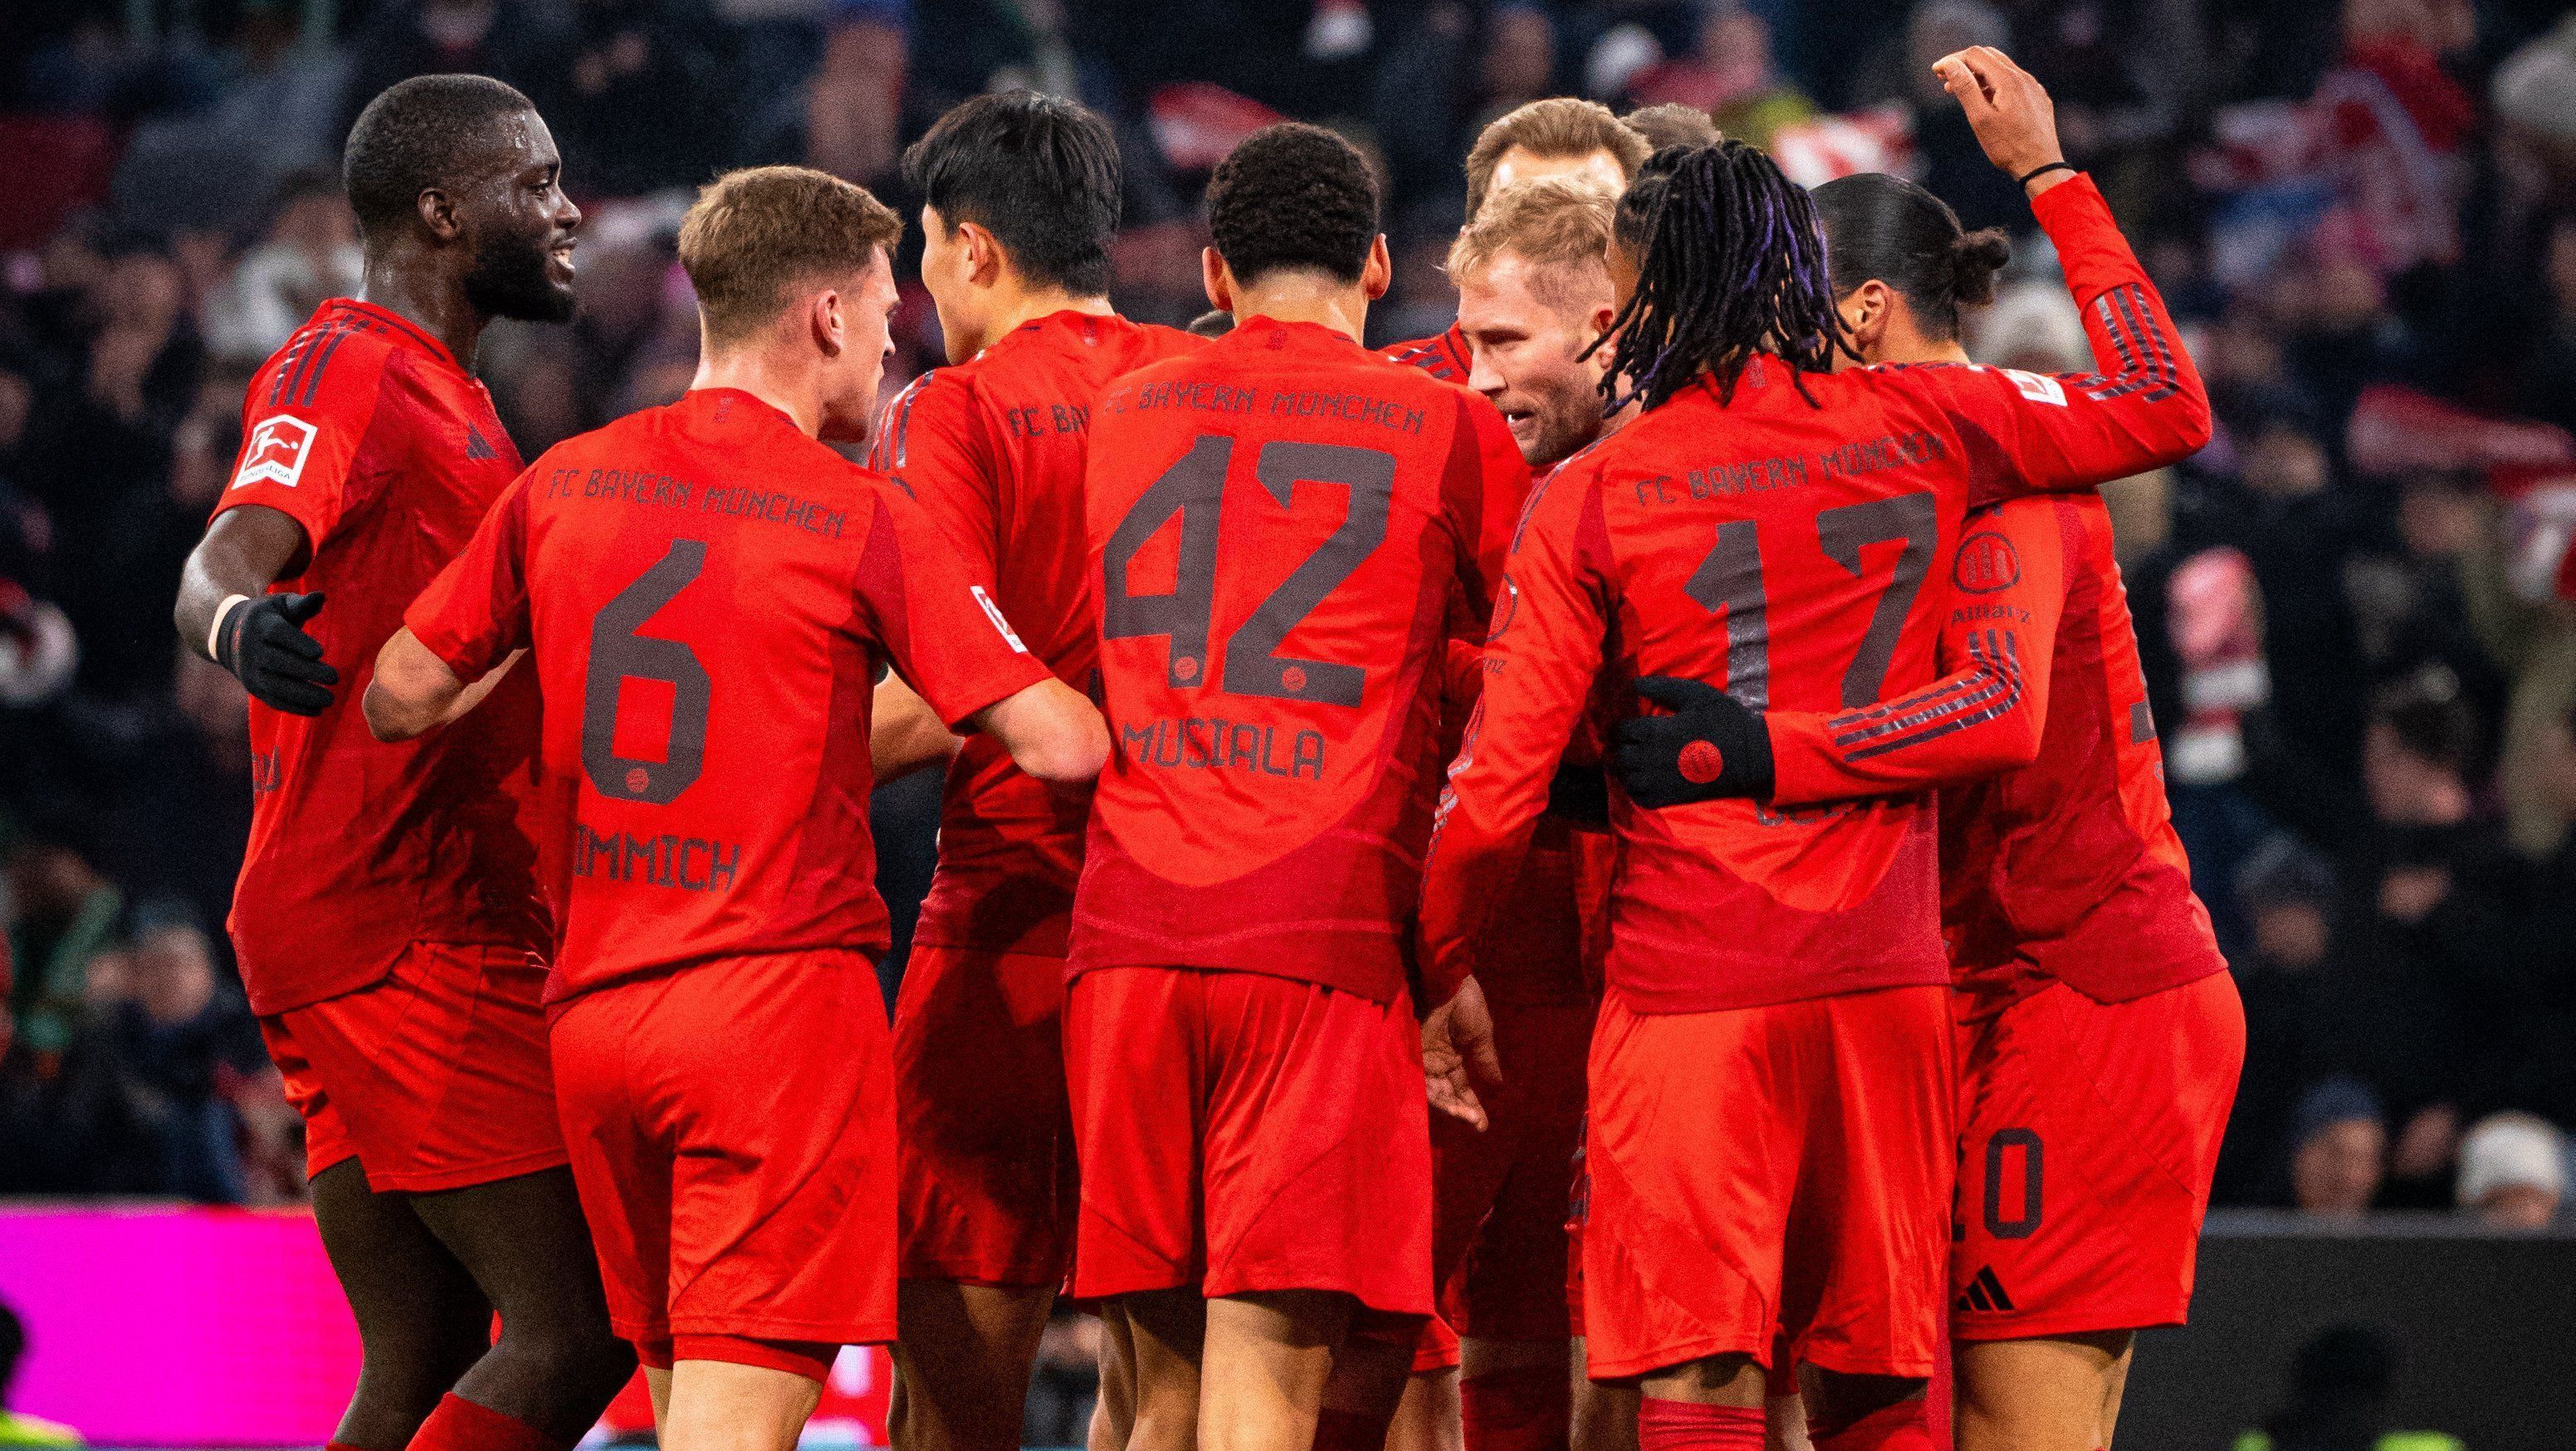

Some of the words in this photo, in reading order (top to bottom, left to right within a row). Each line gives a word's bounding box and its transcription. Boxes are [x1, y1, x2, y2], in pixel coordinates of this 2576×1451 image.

[1007, 407, 1044, 438] FC
[1138, 381, 1255, 414] BAYERN
[1270, 390, 1424, 436] MÜNCHEN
[548, 469, 579, 499] FC
[584, 469, 693, 509] BAYERN
[701, 485, 846, 540] MÜNCHEN
[1635, 475, 1676, 509] FC
[1687, 454, 1809, 501] BAYERN
[1103, 434, 1396, 708] 42
[1683, 491, 1938, 716] 17
[1951, 603, 2031, 626] Allianz
[582, 538, 711, 805] 6
[1122, 717, 1325, 781] MUSIALA
[574, 823, 741, 894] IMMICH
